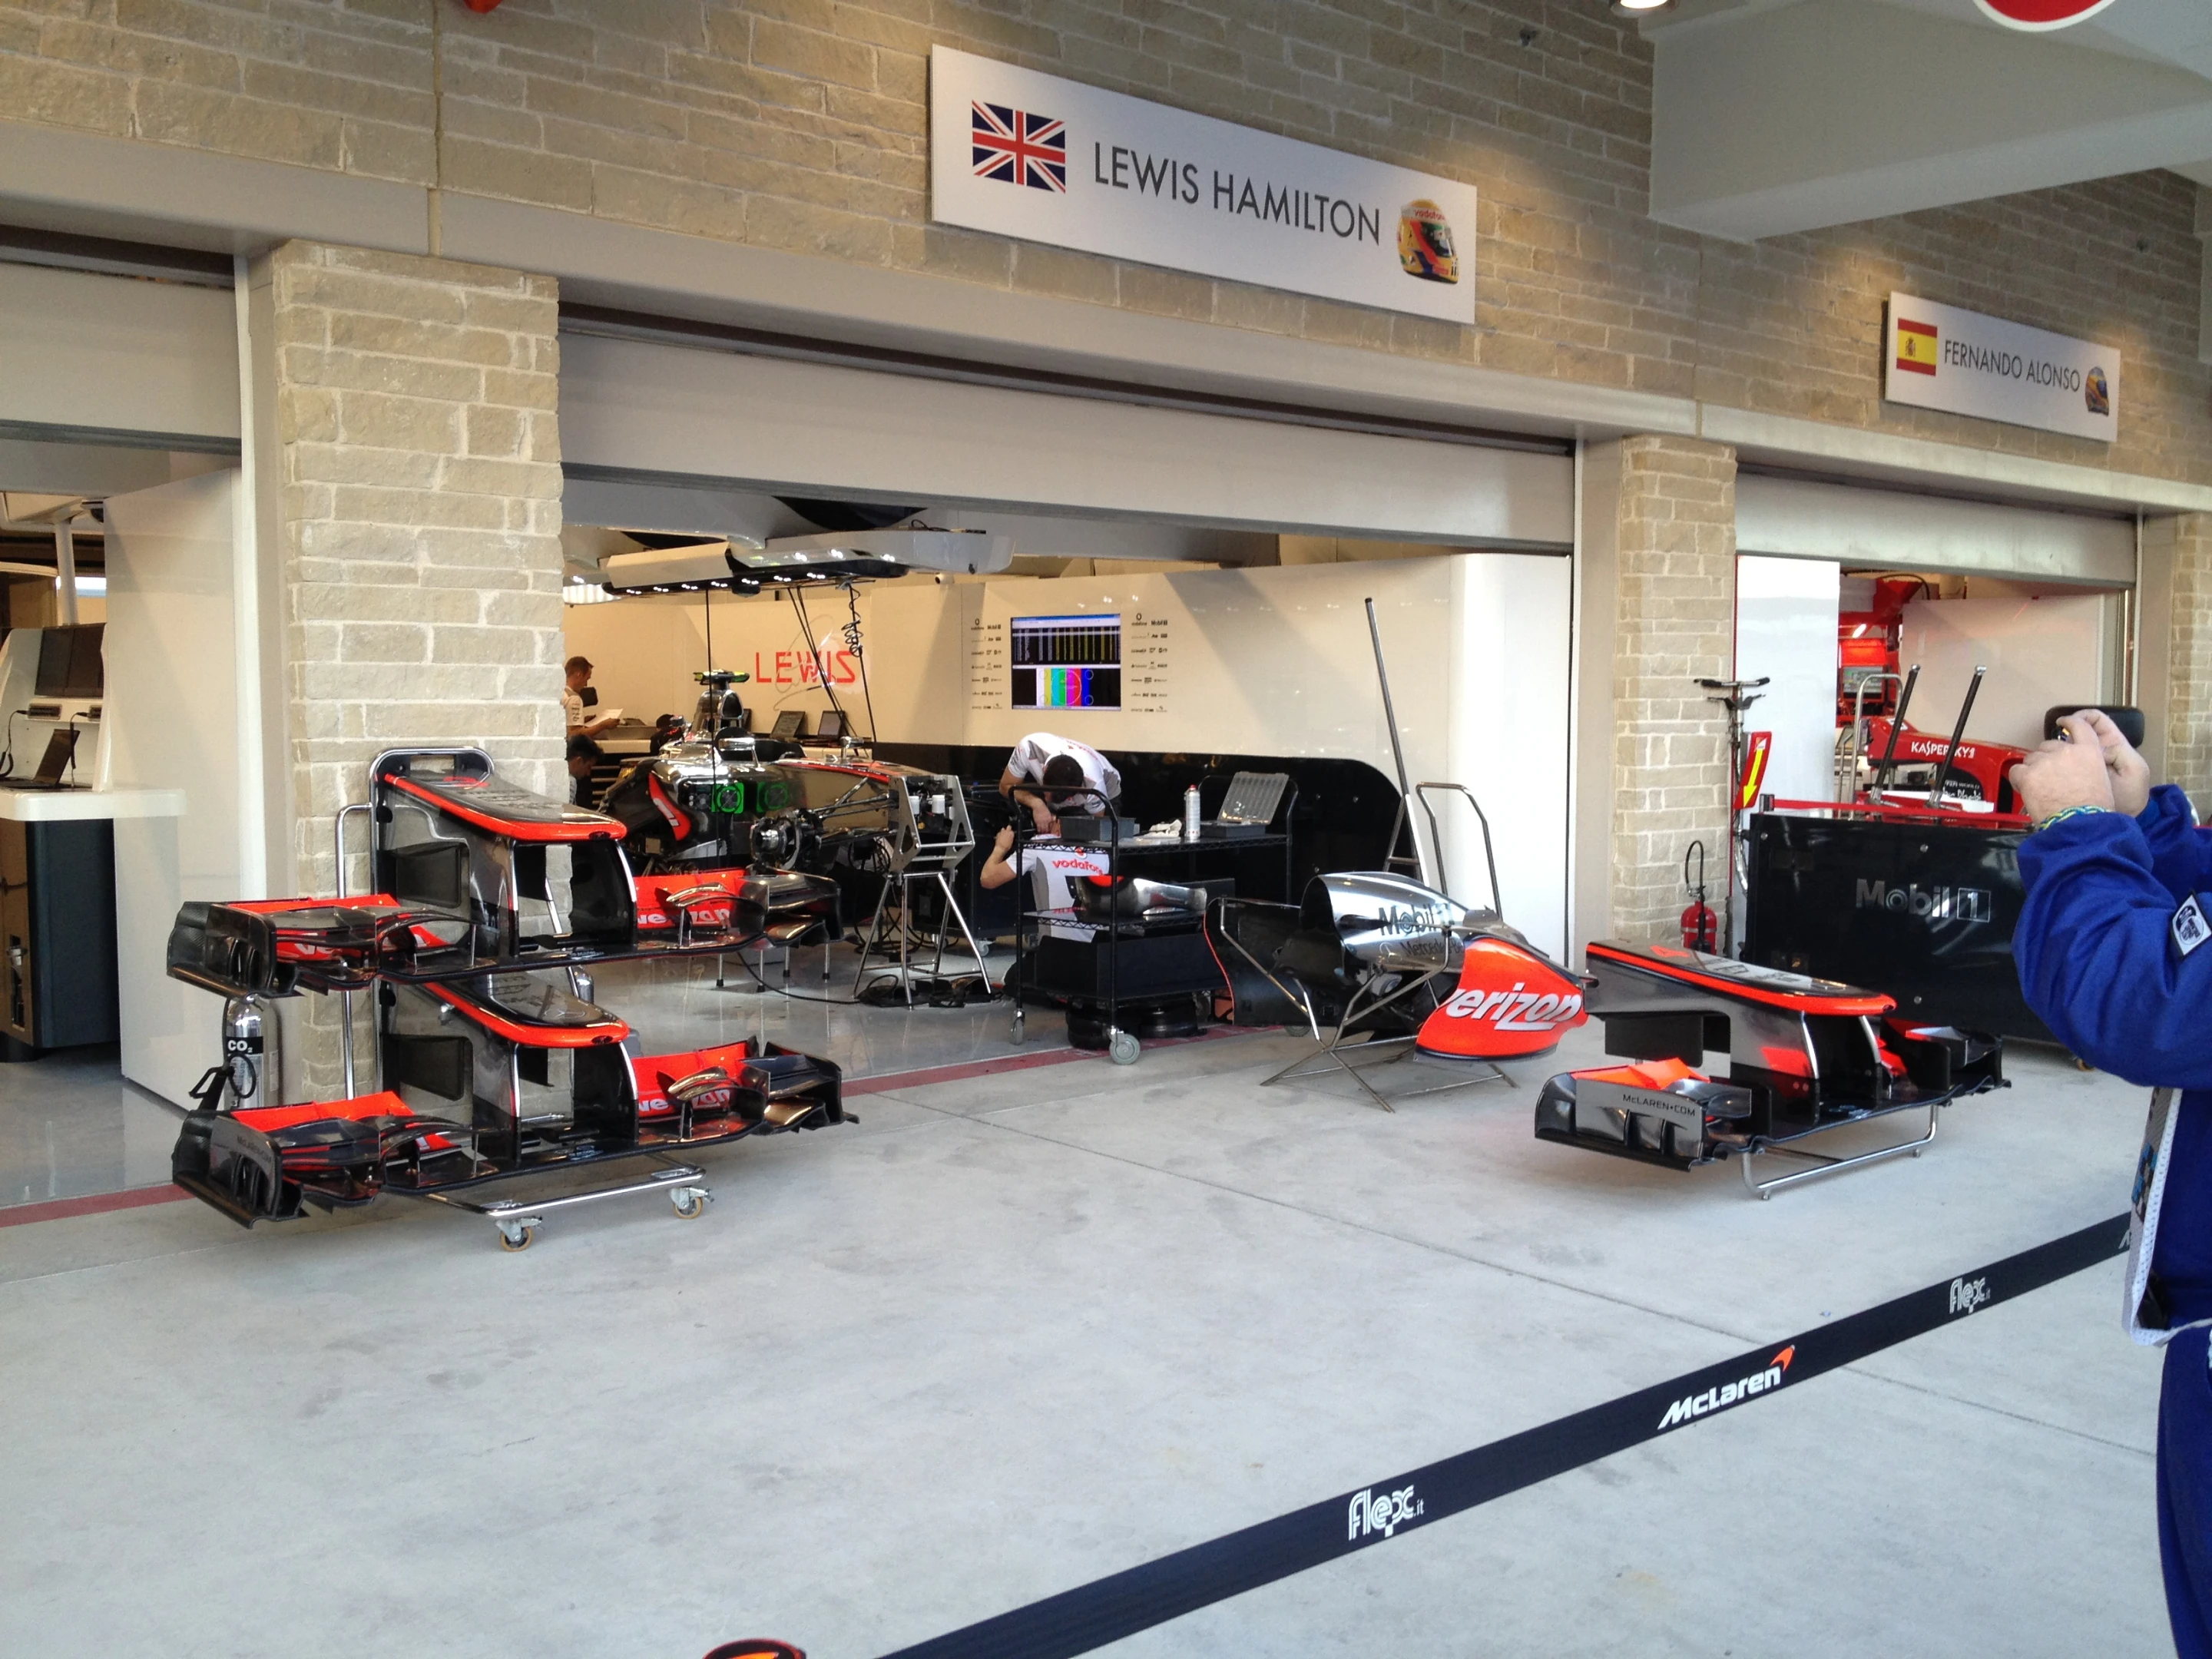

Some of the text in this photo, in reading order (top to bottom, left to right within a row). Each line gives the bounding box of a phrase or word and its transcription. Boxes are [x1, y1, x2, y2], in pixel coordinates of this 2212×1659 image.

[1094, 141, 1381, 246] LEWIS HAMILTON
[1944, 339, 2081, 392] FERNANDO ALONSO
[755, 650, 856, 684] LEWIS
[1379, 904, 1436, 936] Mobil
[1856, 879, 1950, 919] Mobil
[1445, 982, 1583, 1031] verizon
[1657, 1366, 1781, 1430] McLaren
